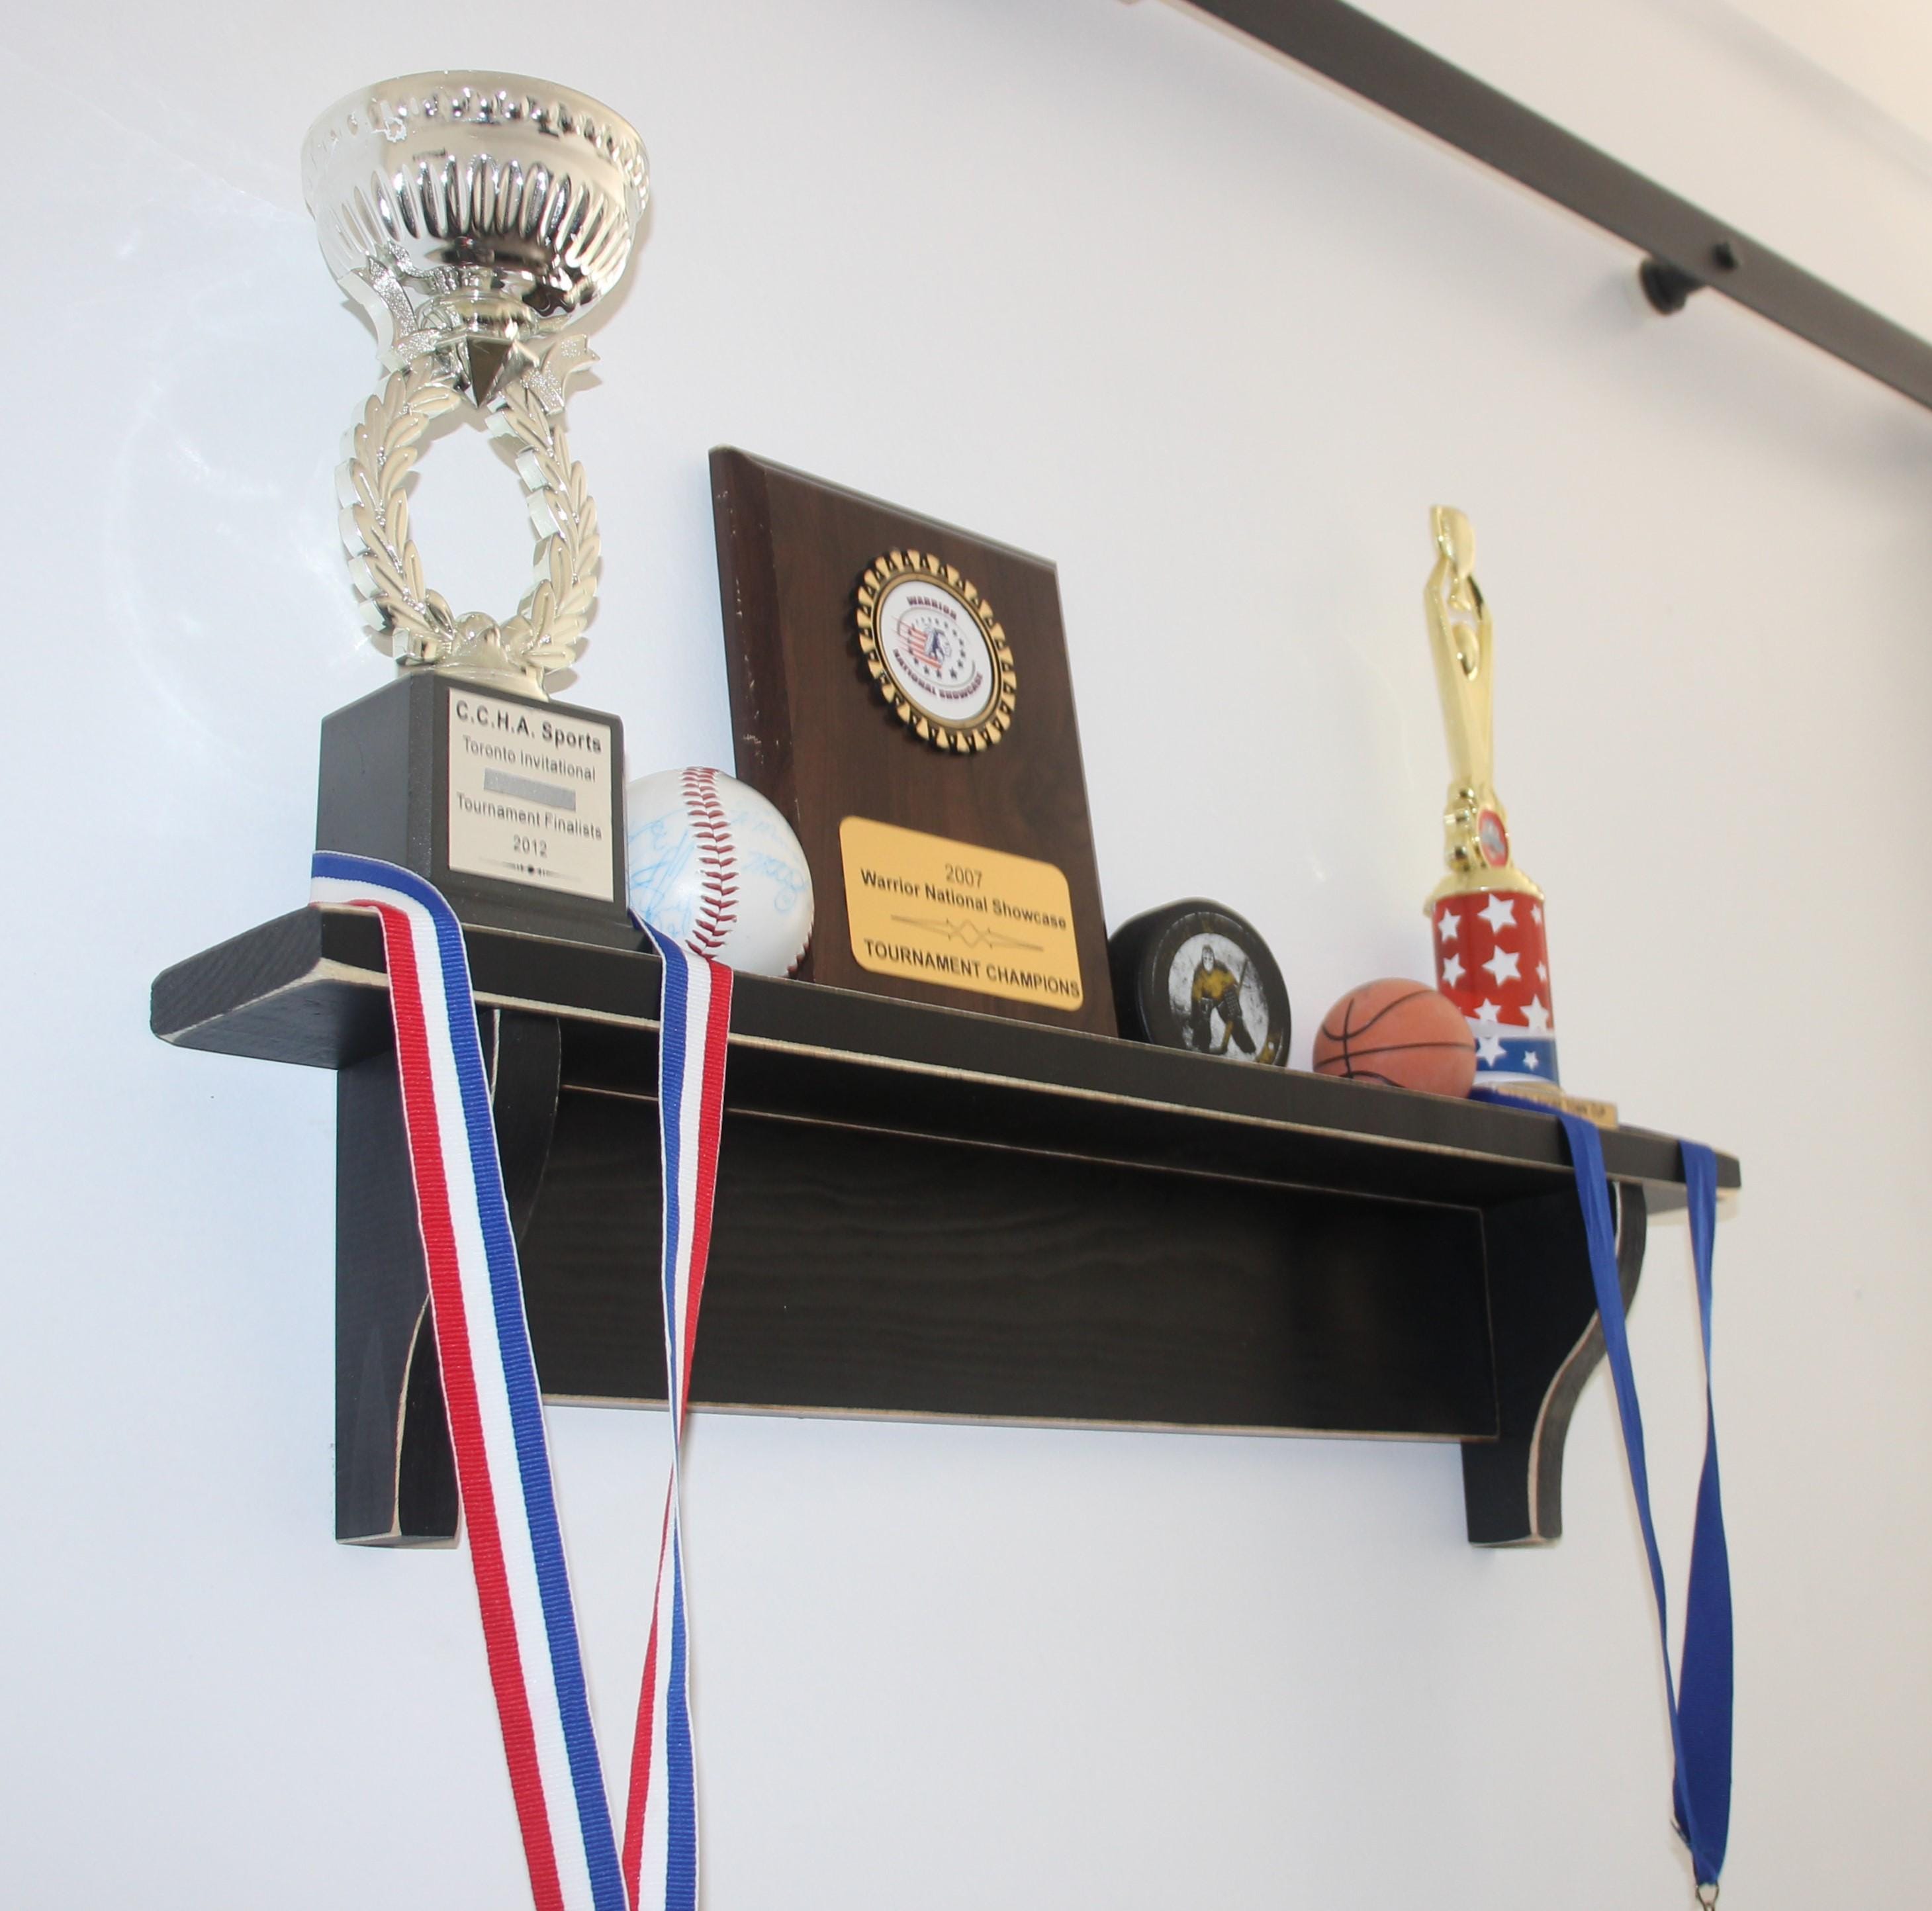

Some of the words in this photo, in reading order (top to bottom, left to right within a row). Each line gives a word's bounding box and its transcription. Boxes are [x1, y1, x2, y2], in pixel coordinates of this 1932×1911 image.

[456, 700, 535, 738] C.C.H.A.
[542, 722, 602, 753] Sports
[463, 734, 516, 763] Toronto
[521, 752, 596, 782] Invitational
[457, 792, 539, 827] Tournament
[545, 813, 602, 839] Finalists
[514, 834, 547, 858] 2012
[860, 868, 919, 897] Warrior
[925, 884, 988, 912] National
[993, 899, 1067, 930] Showcase
[945, 863, 982, 888] 2007
[864, 938, 981, 978] TOURNAMENT
[986, 963, 1080, 998] CHAMPIONS
